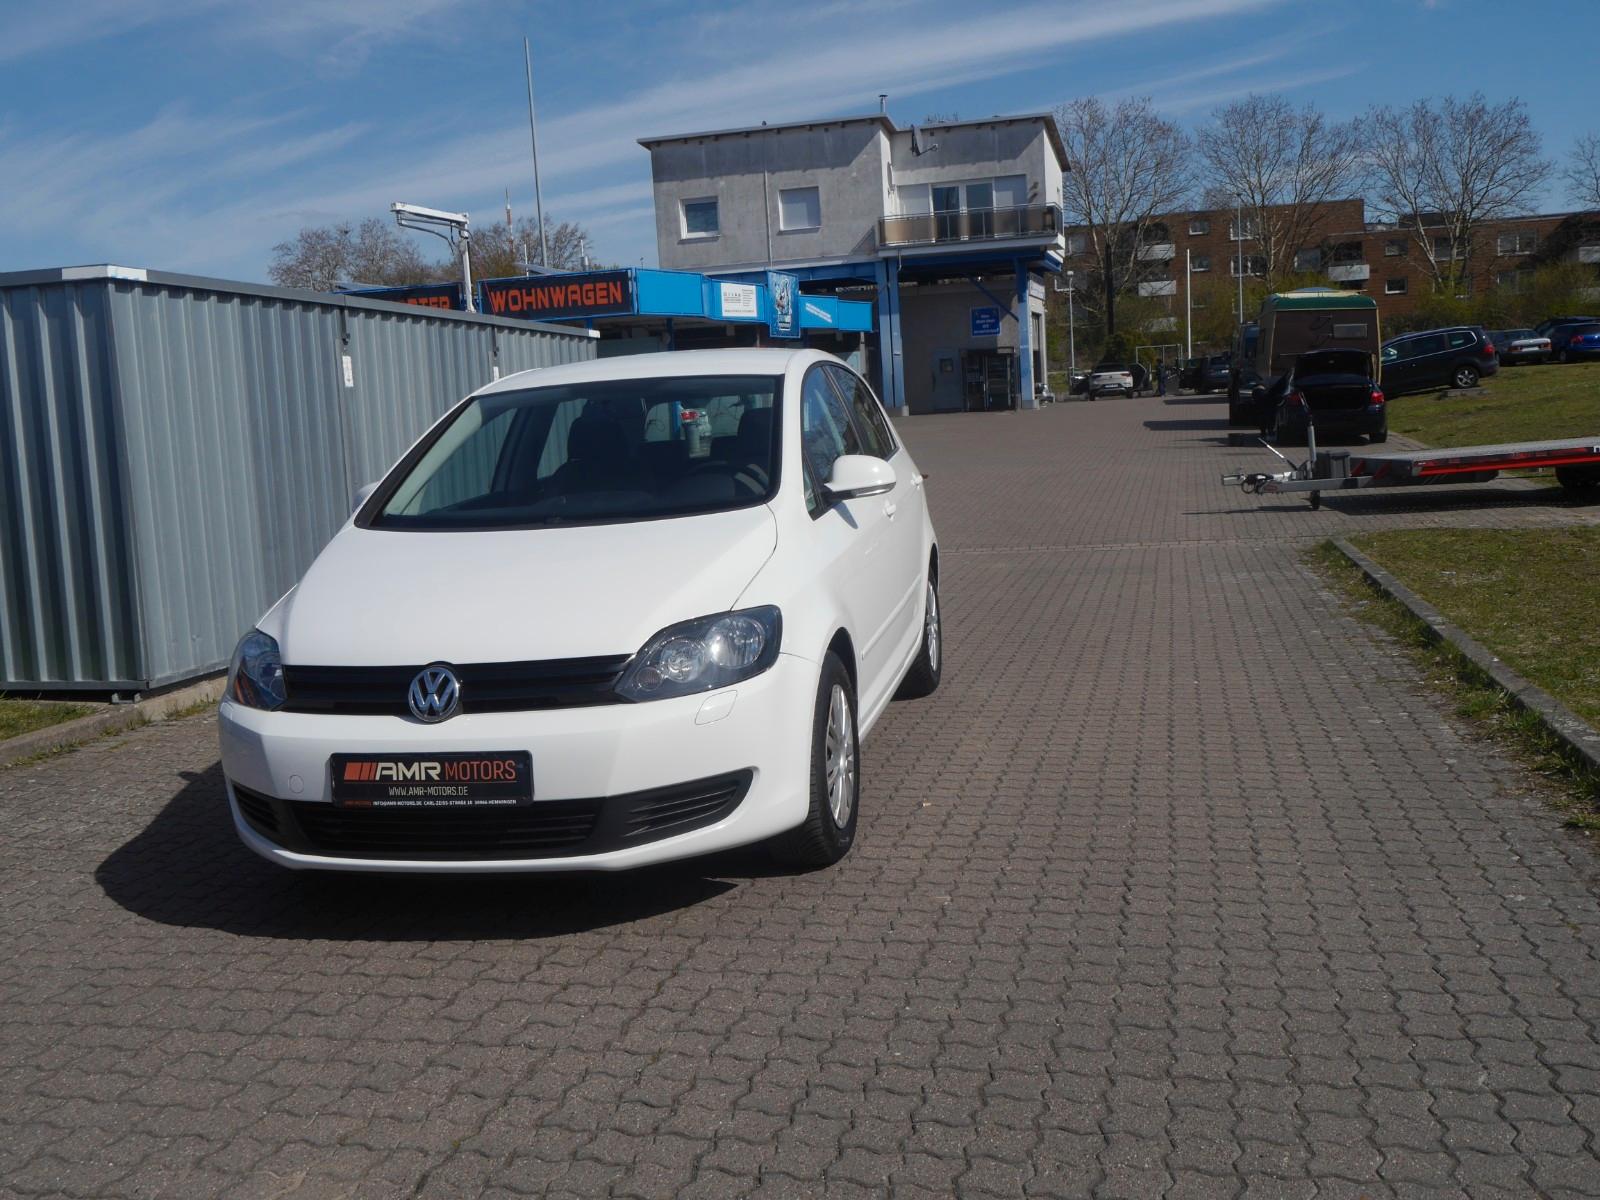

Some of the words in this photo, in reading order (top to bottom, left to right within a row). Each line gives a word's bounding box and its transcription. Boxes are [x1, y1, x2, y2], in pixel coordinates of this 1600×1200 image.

[490, 281, 623, 313] WOHNWAGEN
[375, 762, 441, 781] AMR
[444, 760, 516, 781] MOTORS
[388, 786, 468, 797] WWW.AMR-MOTORS.DE
